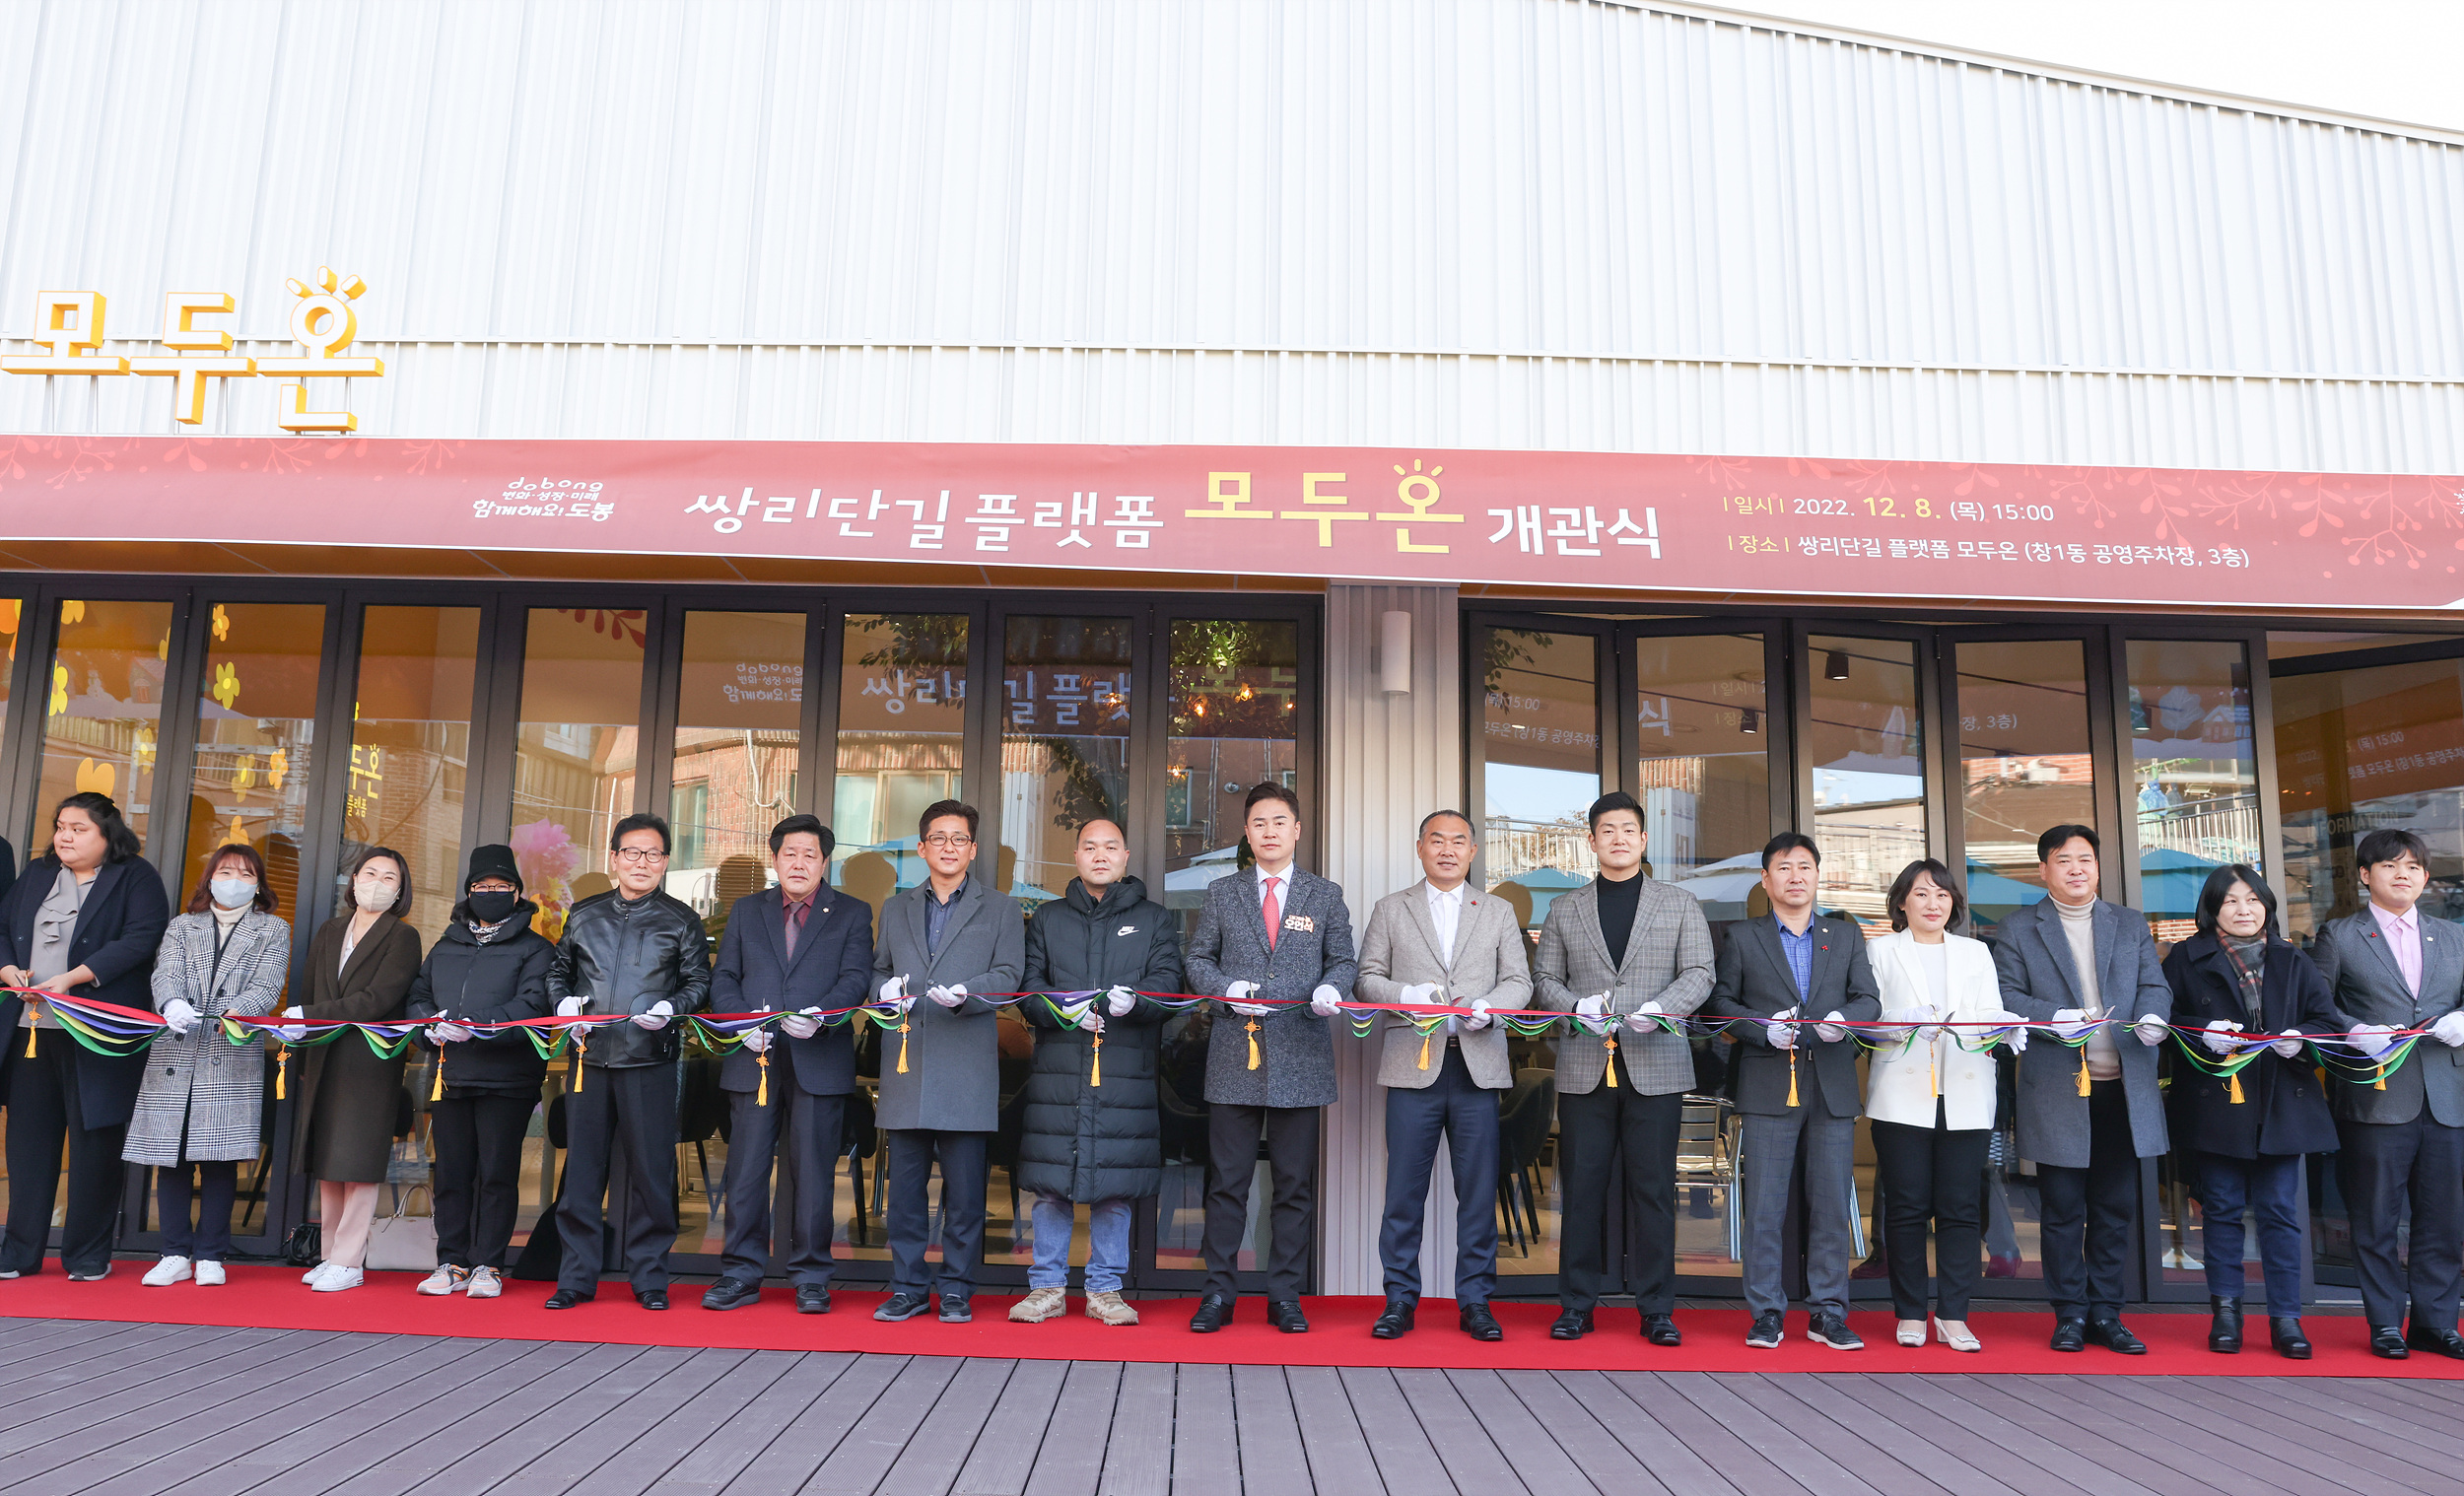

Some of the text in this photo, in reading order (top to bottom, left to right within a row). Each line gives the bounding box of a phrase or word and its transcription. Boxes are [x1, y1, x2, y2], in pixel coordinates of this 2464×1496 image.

[1, 266, 384, 432] 모두온
[508, 477, 603, 492] dobong
[684, 458, 1662, 560] 쌍리단길 플랫폼 모두온 개관식
[1793, 498, 1856, 516] 2022.
[1863, 497, 1906, 518] 12.
[1949, 501, 1985, 522] (목)
[1993, 504, 2055, 522] 15:00
[1797, 535, 1882, 559] 쌍리단길
[1887, 538, 1951, 560] 플랫폼
[1956, 541, 2019, 562] 모두온
[2023, 542, 2088, 565] (창1동
[2092, 545, 2204, 569] 공영주차장,
[2209, 549, 2250, 570] 3층)
